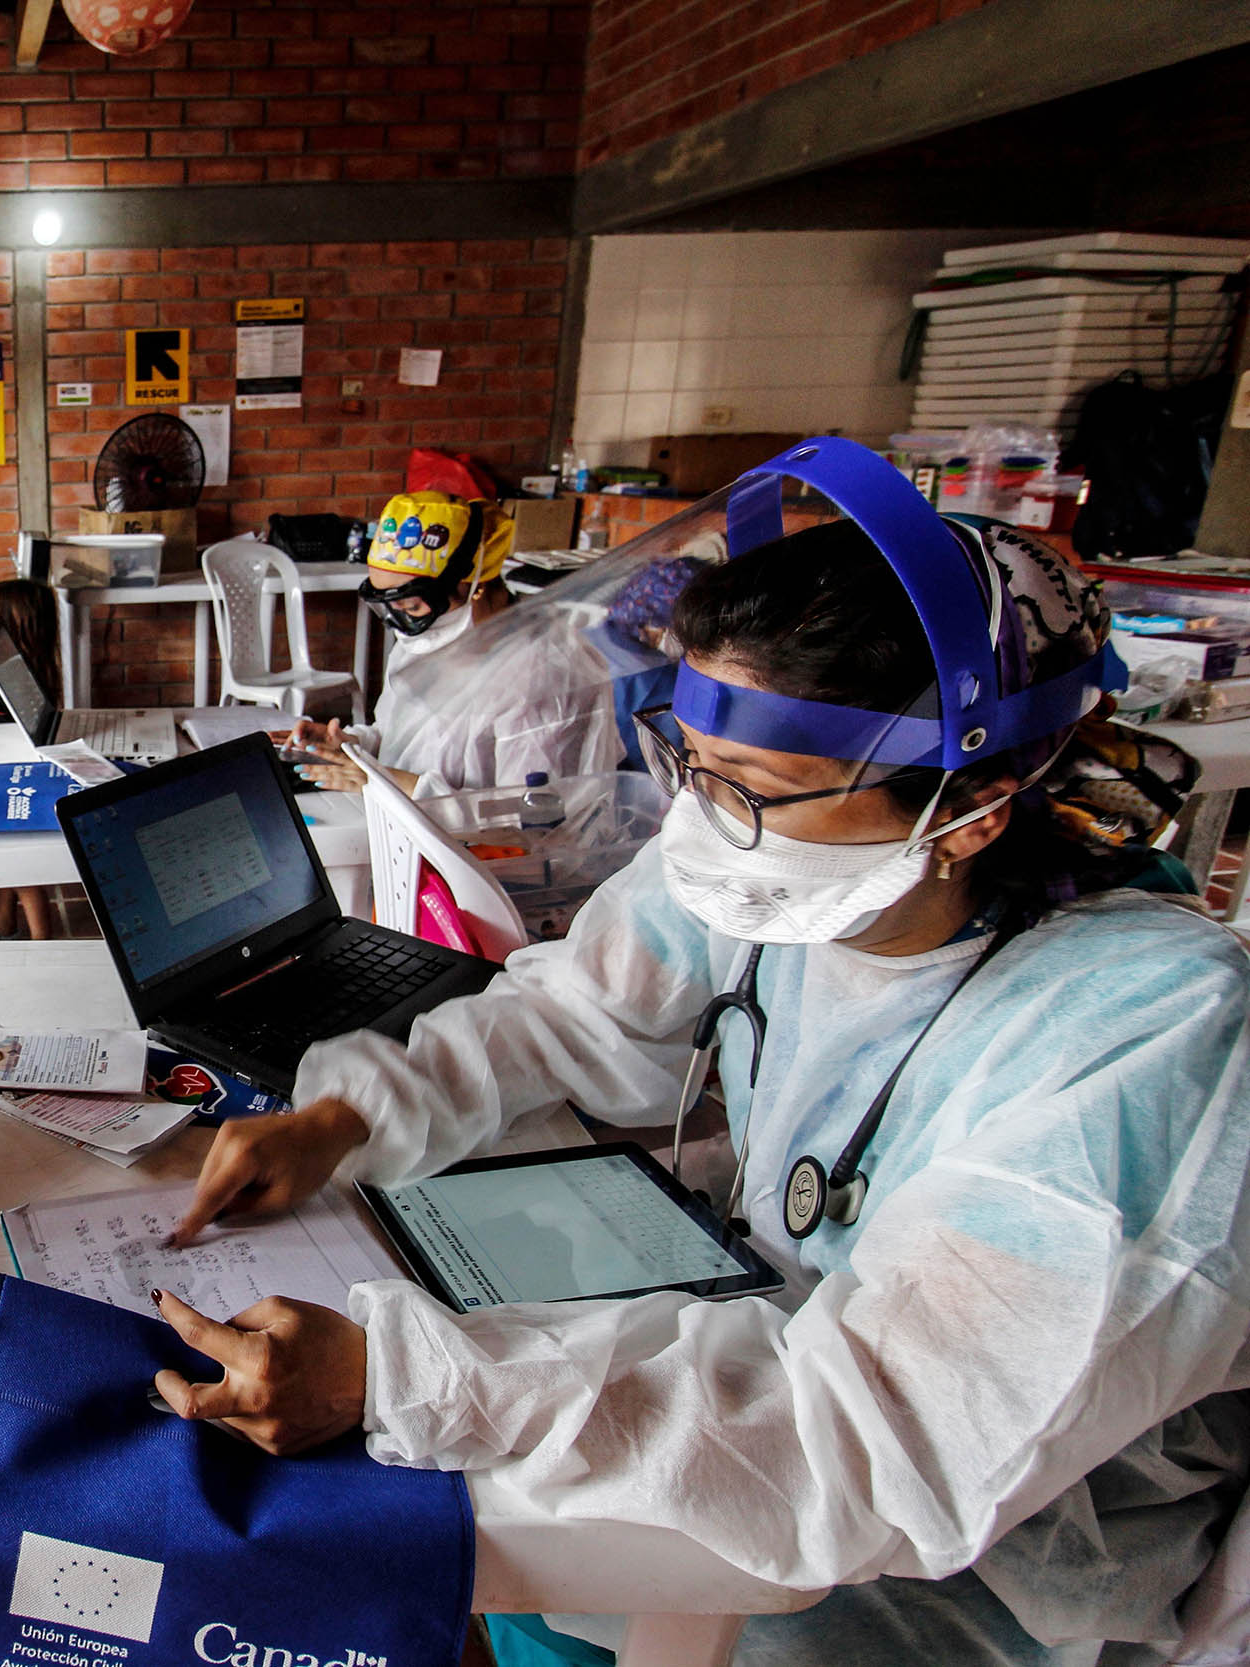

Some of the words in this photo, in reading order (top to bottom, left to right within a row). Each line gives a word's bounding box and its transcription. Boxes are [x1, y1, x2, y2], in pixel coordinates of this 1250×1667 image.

[135, 389, 179, 398] RESCUE
[425, 534, 440, 546] m
[21, 1624, 64, 1644] Unión
[68, 1634, 128, 1658] Europea
[194, 1623, 356, 1667] Cana
[12, 1642, 88, 1667] Protección
